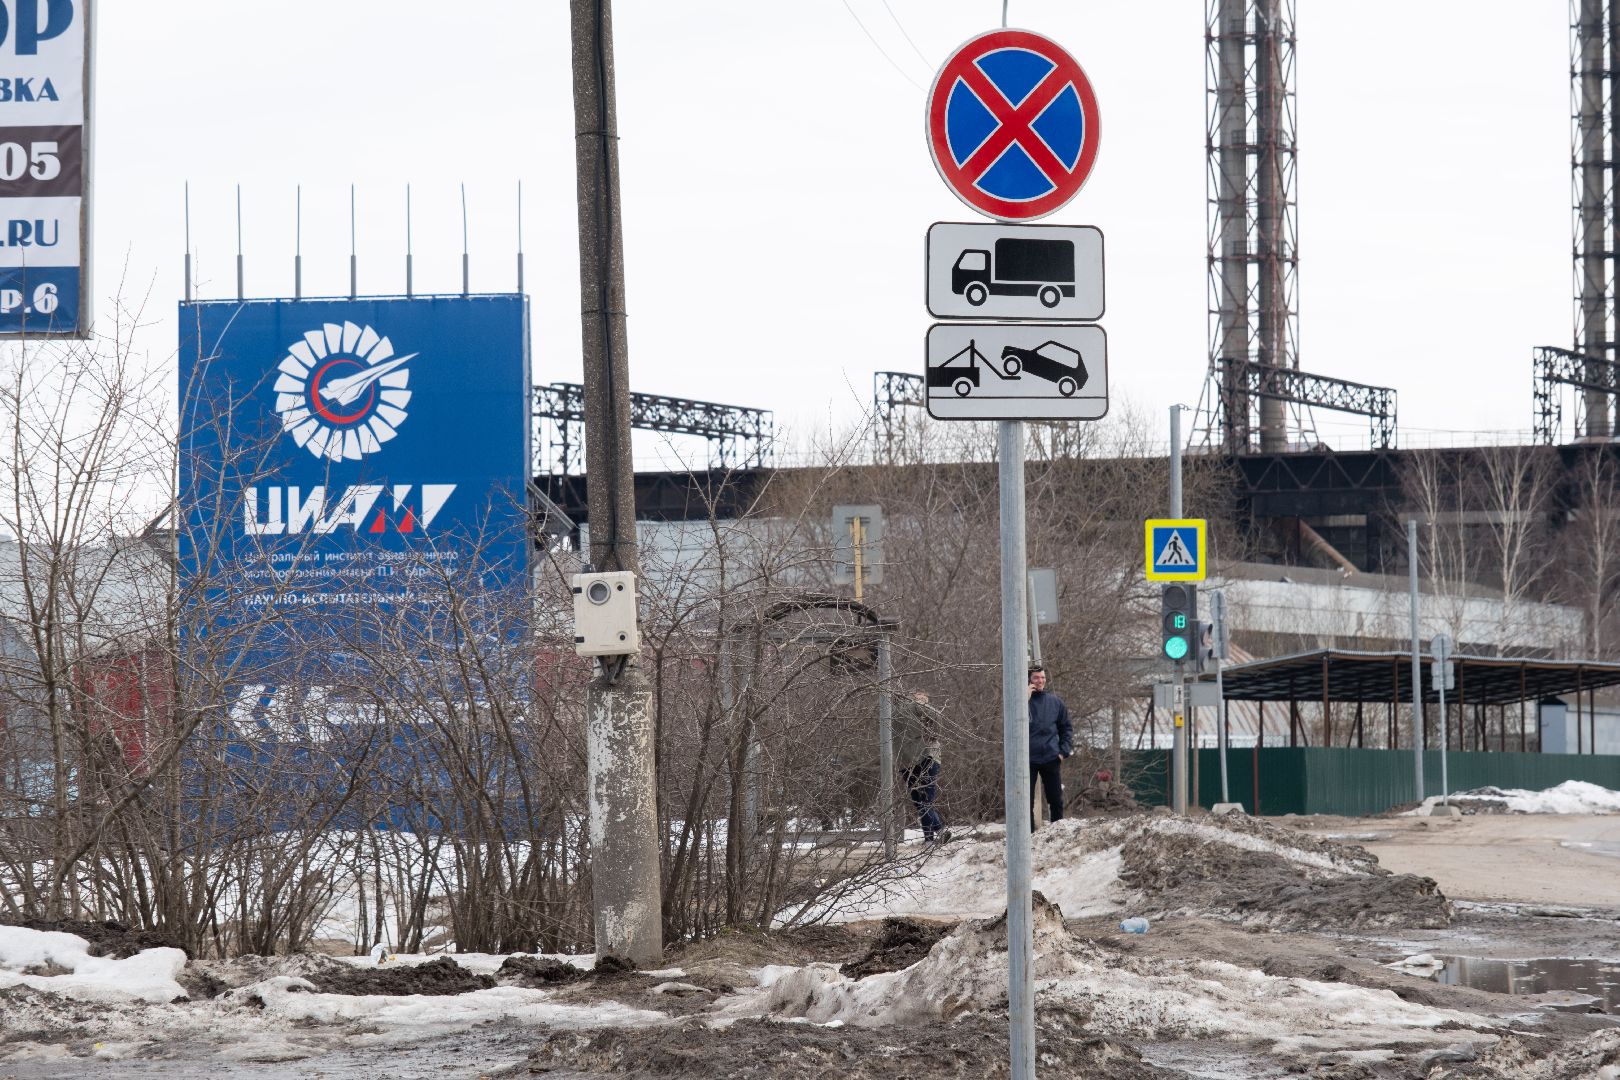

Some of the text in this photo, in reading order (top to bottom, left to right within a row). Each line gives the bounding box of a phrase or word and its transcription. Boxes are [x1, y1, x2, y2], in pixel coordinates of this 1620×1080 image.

[0, 0, 73, 55] Р
[0, 142, 61, 180] 05
[244, 484, 457, 535] ЦИАМ
[245, 550, 320, 564] Цральый
